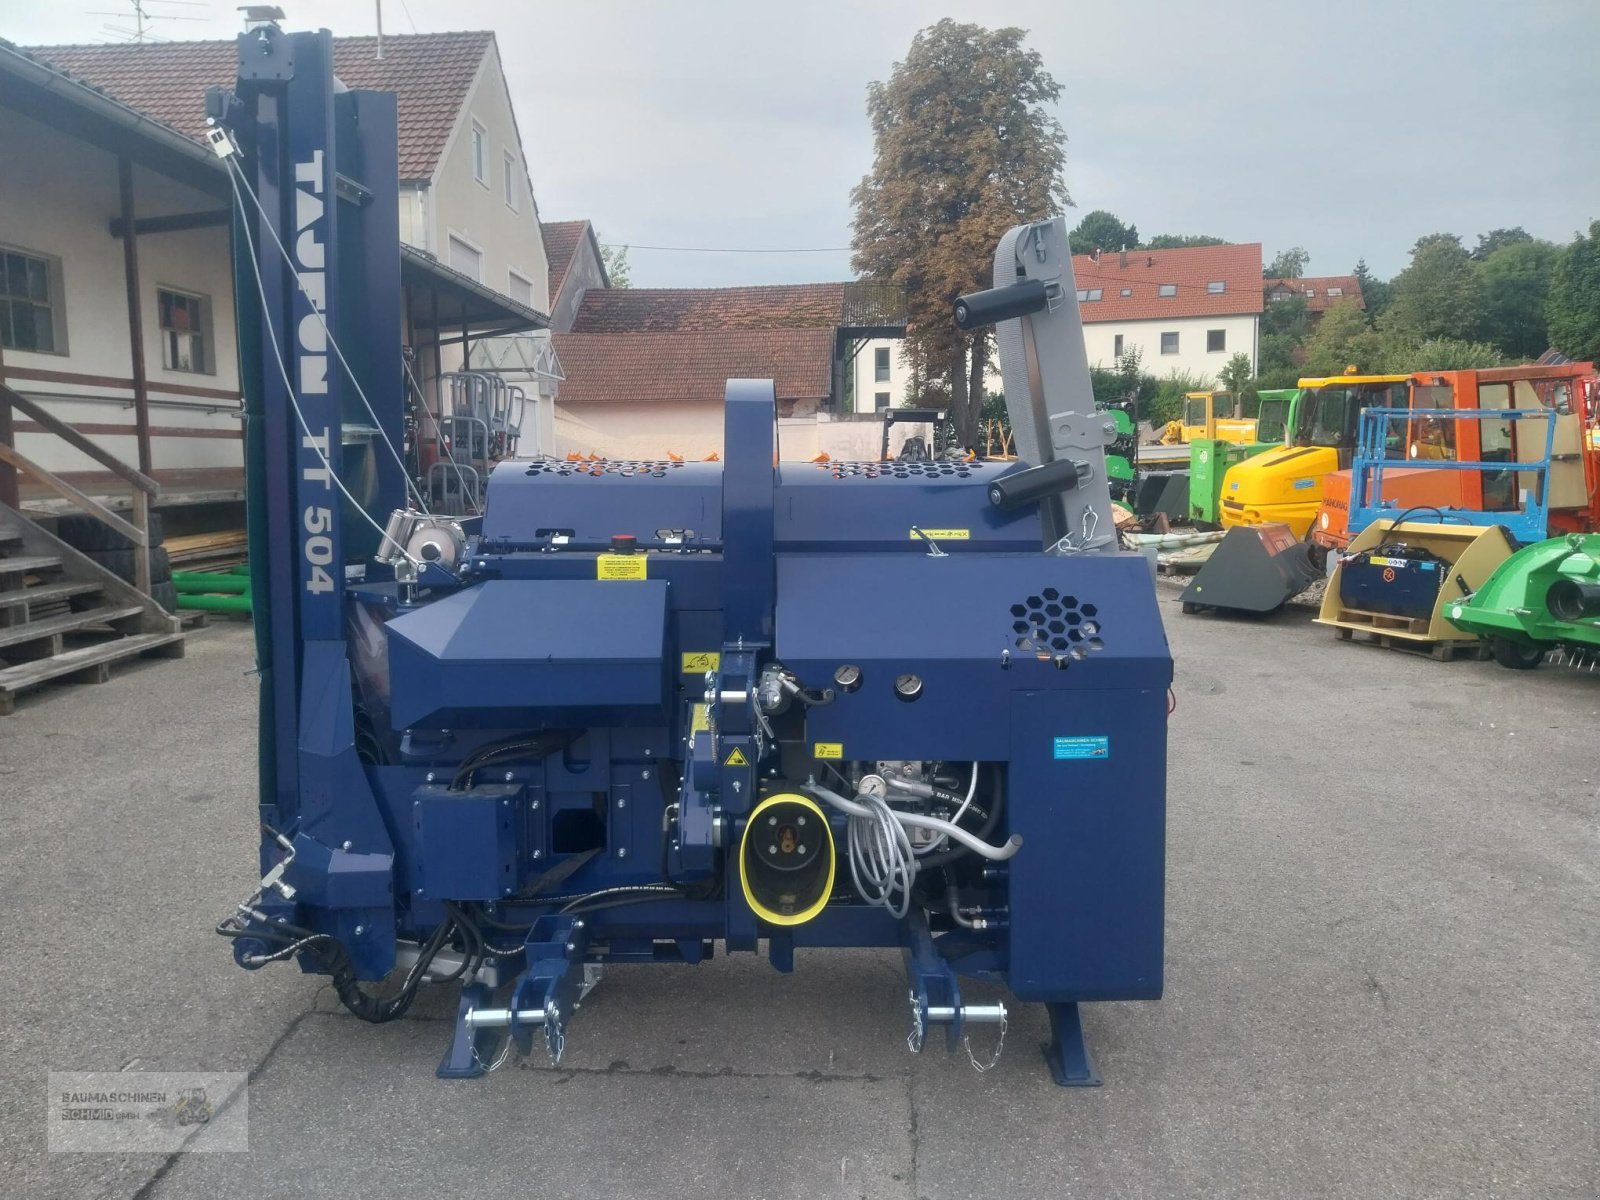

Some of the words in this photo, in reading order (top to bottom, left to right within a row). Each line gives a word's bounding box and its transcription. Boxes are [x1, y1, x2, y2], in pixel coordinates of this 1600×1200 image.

[295, 149, 328, 394] TAJFUN
[302, 426, 331, 490] TT
[303, 504, 334, 596] 504
